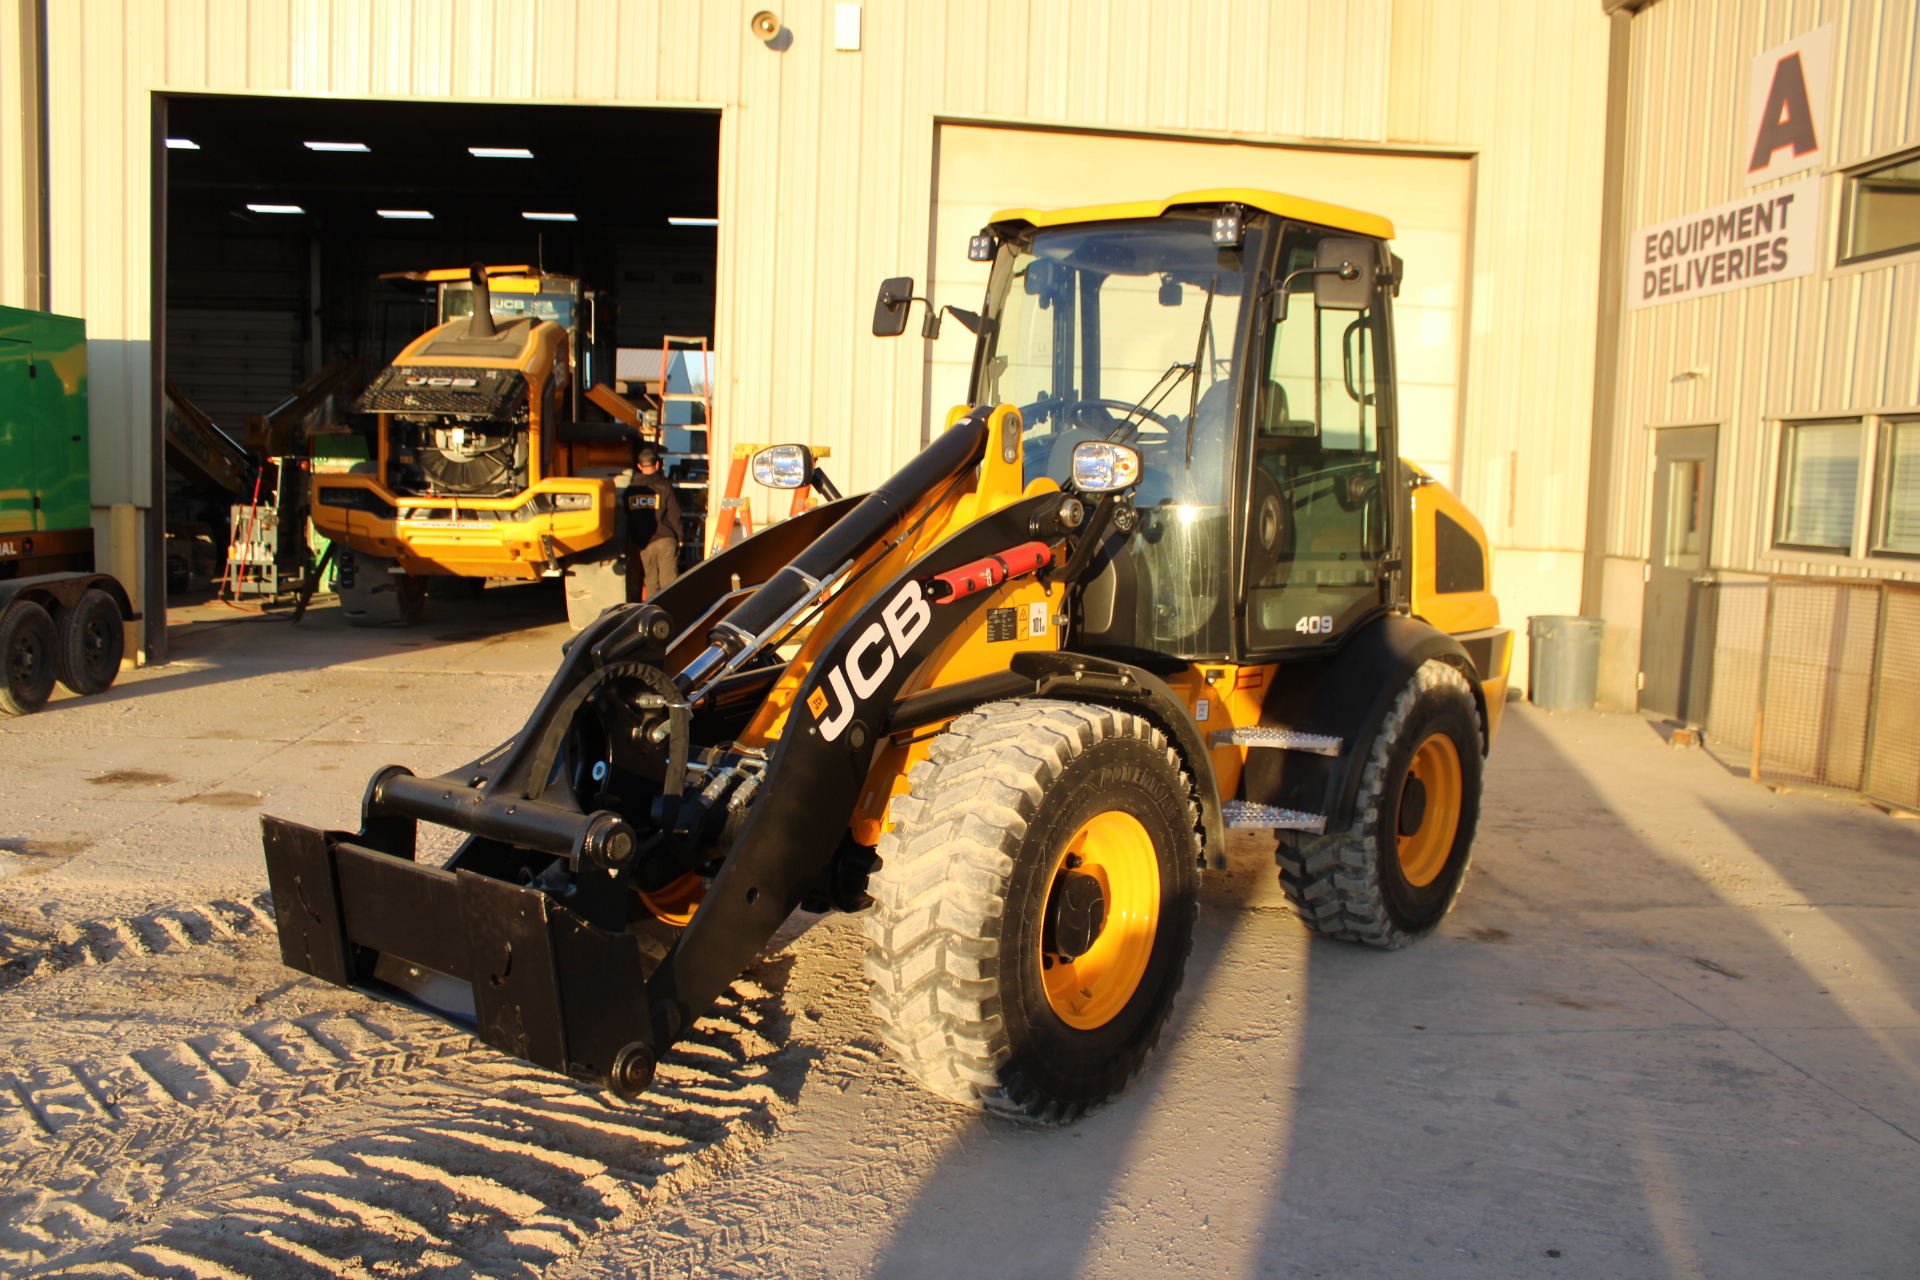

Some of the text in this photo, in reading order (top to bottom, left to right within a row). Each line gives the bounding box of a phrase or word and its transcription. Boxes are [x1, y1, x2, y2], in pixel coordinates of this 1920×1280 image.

[1747, 50, 1818, 174] A
[1645, 193, 1794, 265] EQUIPMENT
[1643, 237, 1788, 300] DELIVERIES
[495, 299, 525, 309] JCB
[406, 377, 478, 387] JCB
[632, 497, 657, 507] JCB
[1295, 615, 1333, 635] 409
[819, 580, 931, 742] JCB
